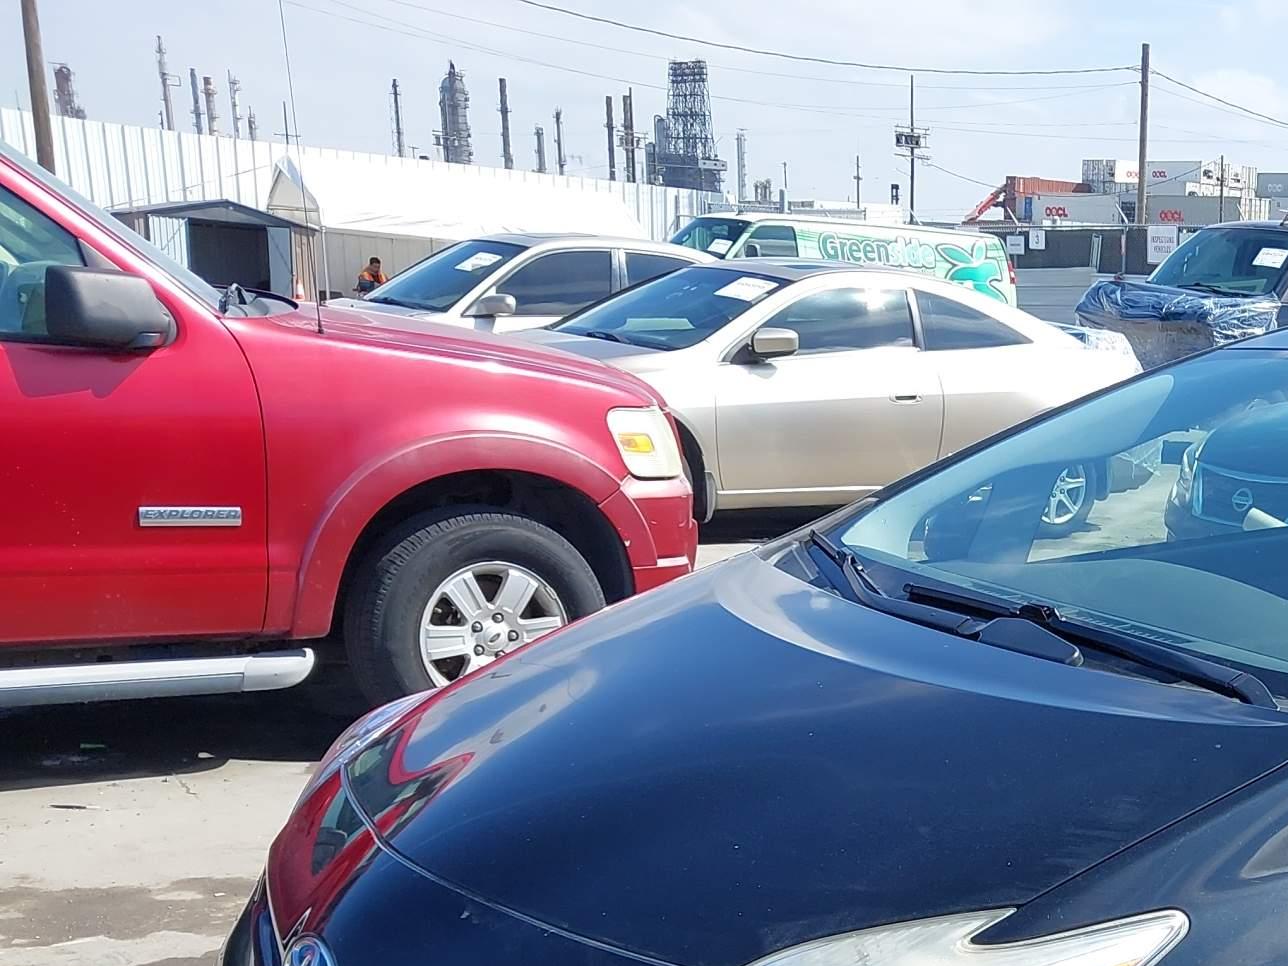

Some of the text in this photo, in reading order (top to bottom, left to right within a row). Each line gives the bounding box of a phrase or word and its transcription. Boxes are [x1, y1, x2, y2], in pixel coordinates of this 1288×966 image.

[1045, 206, 1068, 217] OOCL
[1159, 210, 1184, 222] OOCL
[143, 509, 240, 520] EXPLORER
